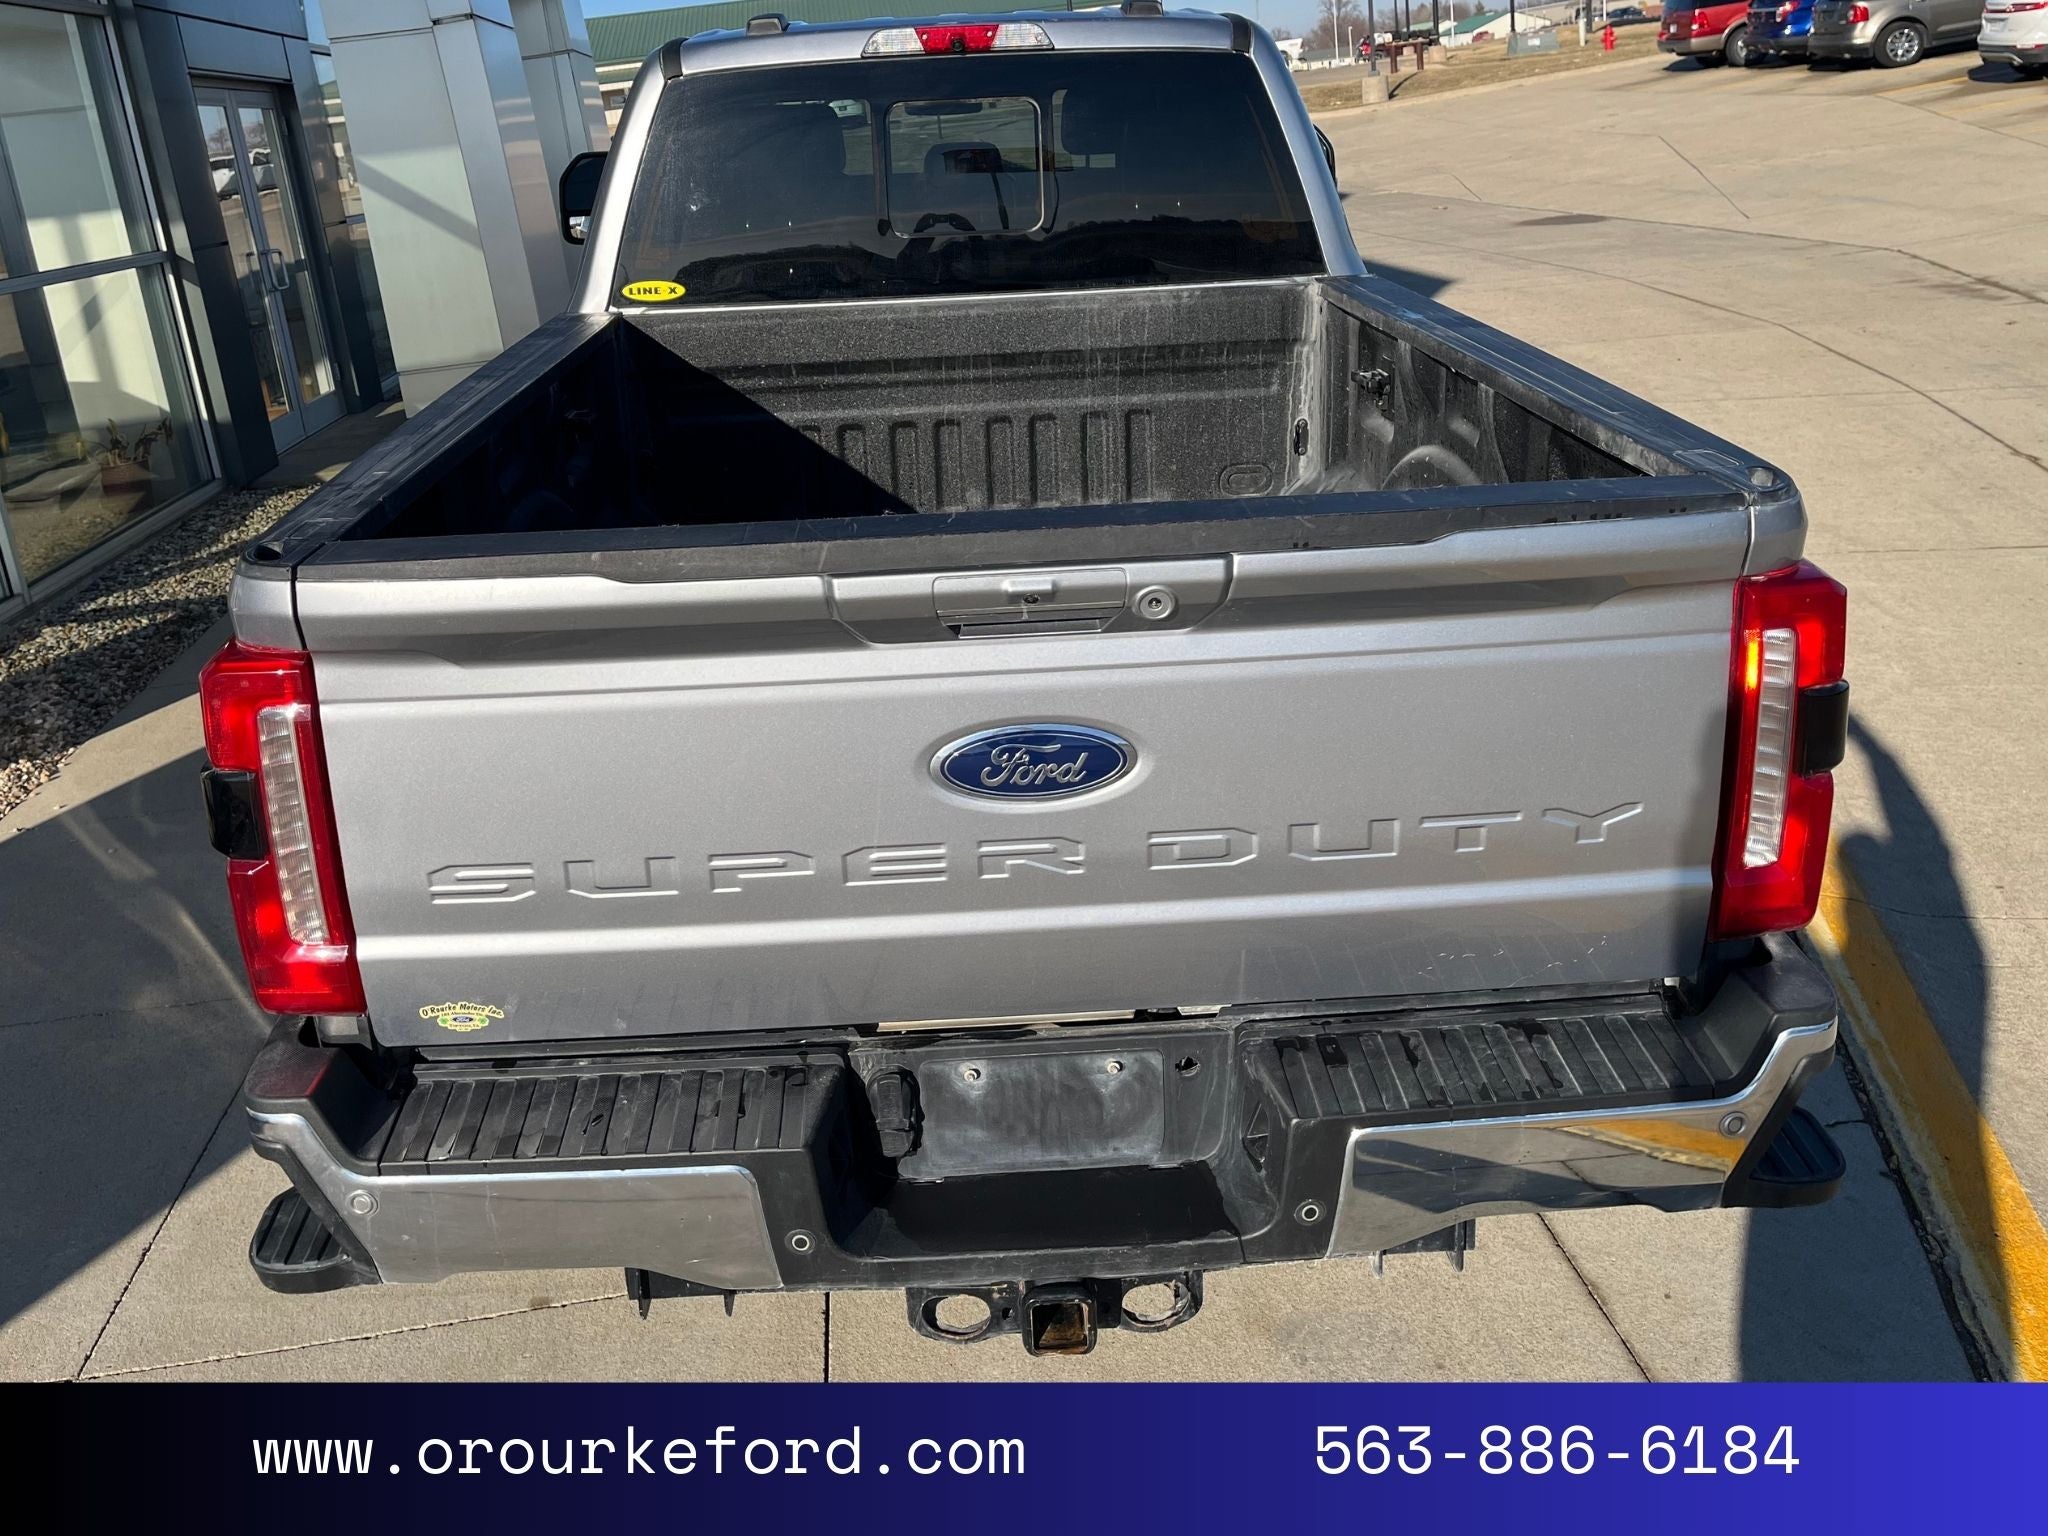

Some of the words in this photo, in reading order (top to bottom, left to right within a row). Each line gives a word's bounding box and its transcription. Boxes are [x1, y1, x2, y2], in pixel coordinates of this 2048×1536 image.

[980, 743, 1089, 787] Ford
[427, 836, 1086, 905] SUPER
[1147, 802, 1645, 870] DUTY
[421, 1004, 457, 1017] O'Rourke
[459, 1003, 486, 1013] Motors
